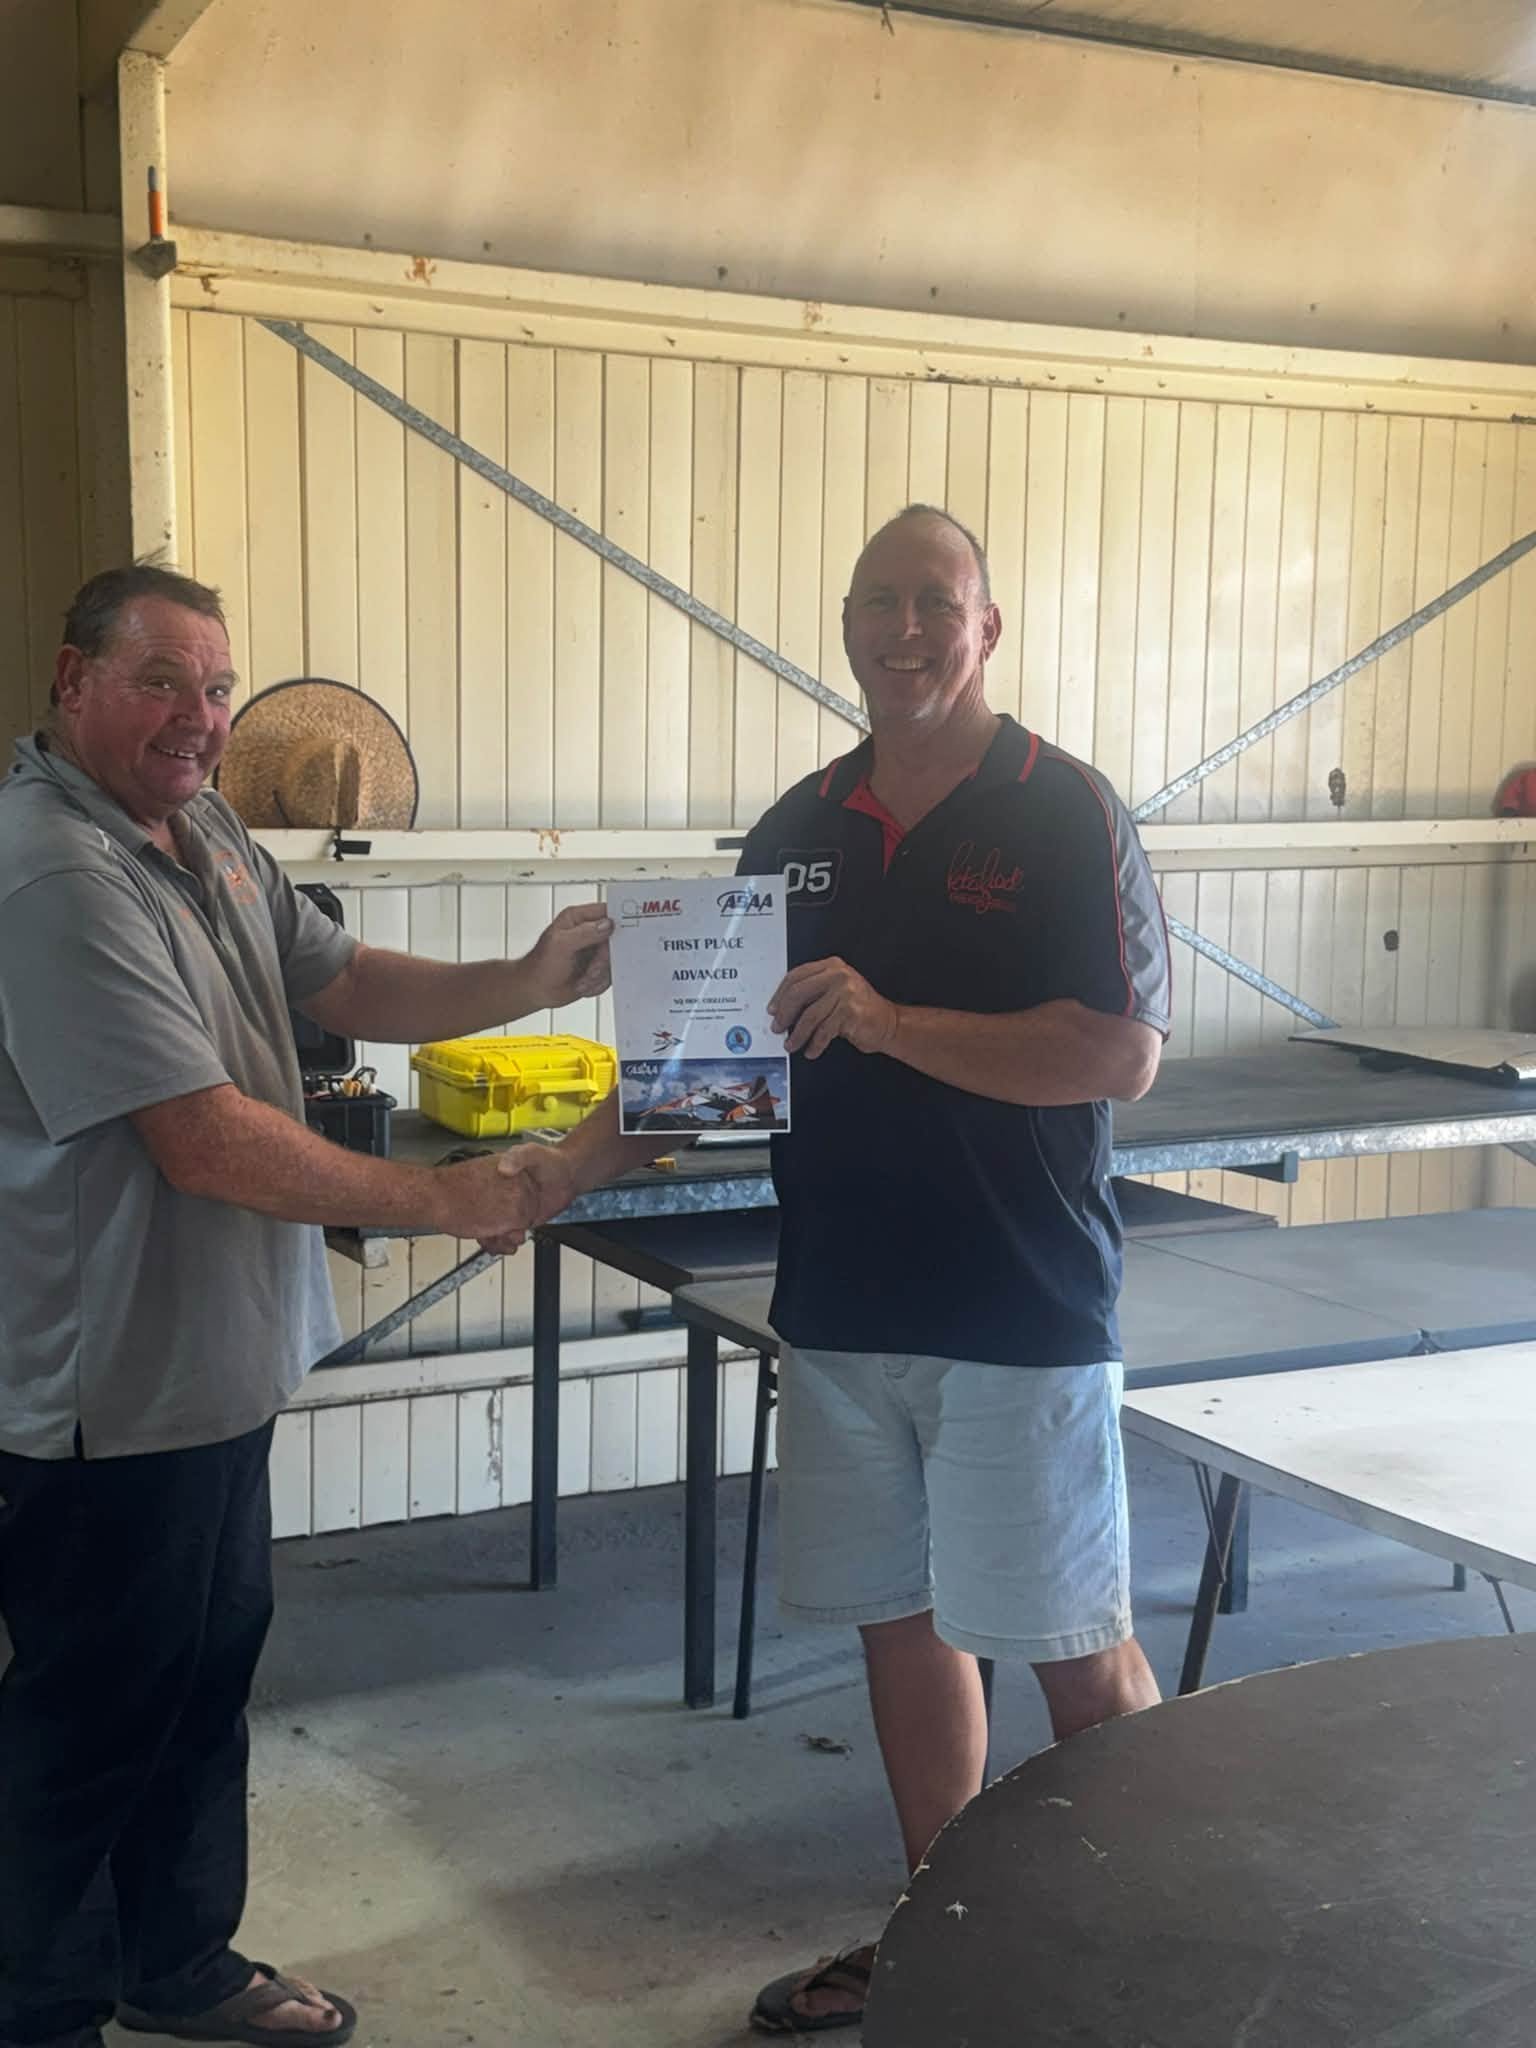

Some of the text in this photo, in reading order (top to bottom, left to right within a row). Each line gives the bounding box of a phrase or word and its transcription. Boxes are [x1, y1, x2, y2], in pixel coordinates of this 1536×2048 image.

[642, 899, 681, 914] IMAC
[664, 937, 744, 951] FIRST PLACE
[672, 968, 738, 981] ADVANCED
